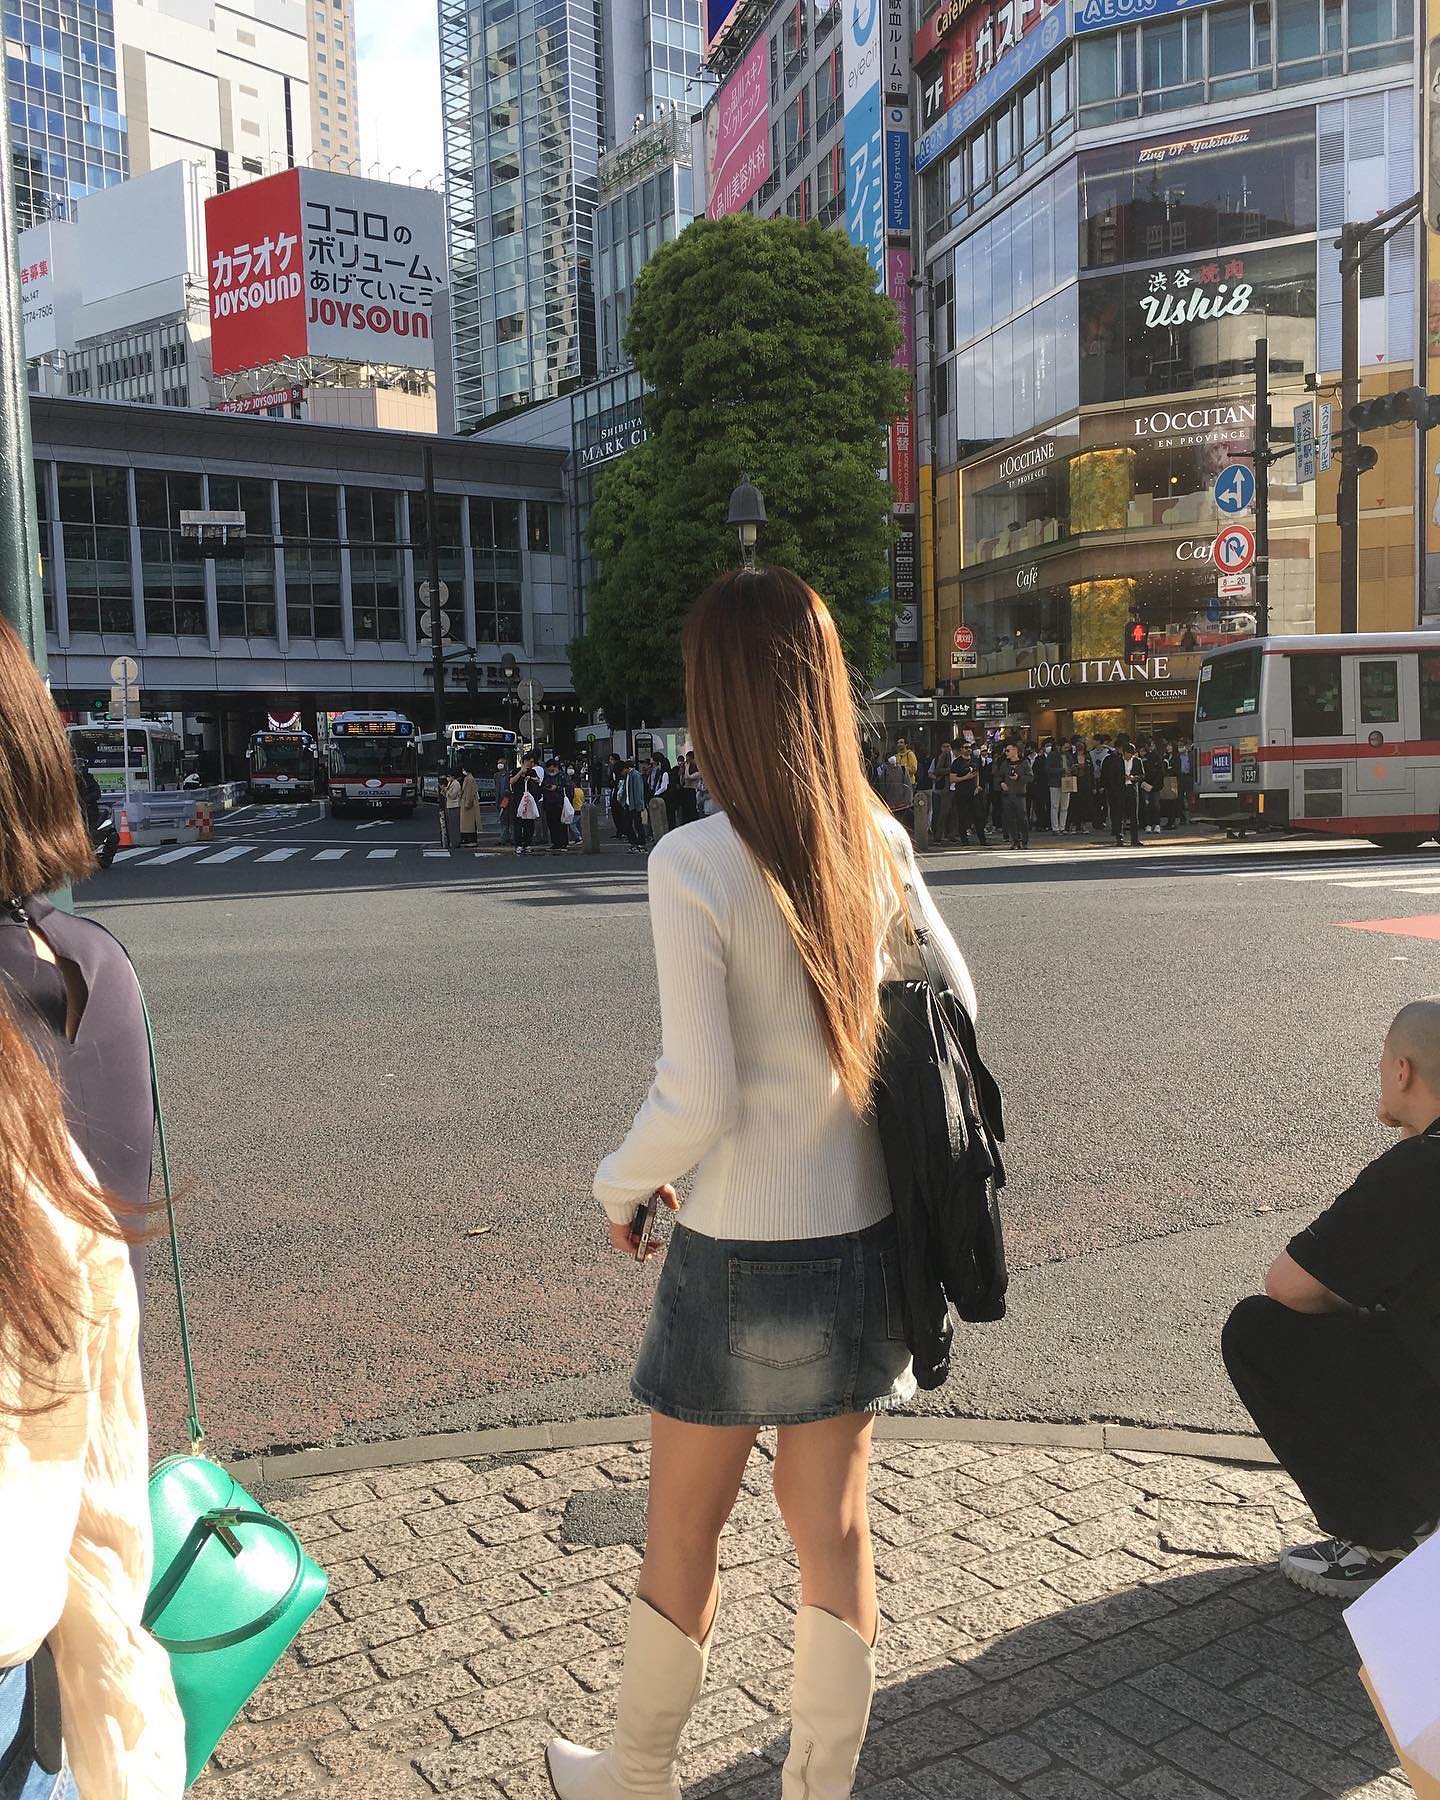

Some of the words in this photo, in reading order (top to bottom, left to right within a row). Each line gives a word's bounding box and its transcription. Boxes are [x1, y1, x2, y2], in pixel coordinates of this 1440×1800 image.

[891, 82, 902, 91] 6F
[925, 75, 944, 118] 7F
[1191, 133, 1249, 153] Yakiniku
[306, 201, 412, 245] ココロの
[212, 232, 298, 290] カラオケ
[213, 272, 301, 319] JOYSOUND
[310, 270, 433, 307] あげていこう
[308, 298, 433, 339] JOYSOUN
[1139, 284, 1253, 328] Ushi8
[253, 391, 288, 408] JOYSOUND
[601, 417, 642, 439] SHIBUYA
[1134, 404, 1257, 436] L'OCCITAN
[581, 437, 625, 463] MARK
[631, 427, 655, 445] CI
[1158, 440, 1173, 448] EN
[1180, 430, 1245, 445] PROVENCE
[1302, 409, 1313, 476] 渋谷駅前
[1000, 442, 1055, 479] L'OCCITANE
[897, 503, 910, 512] 7F
[1176, 540, 1217, 564] Caf
[1016, 567, 1038, 590] Café
[1145, 689, 1187, 697] L'OCCITANE
